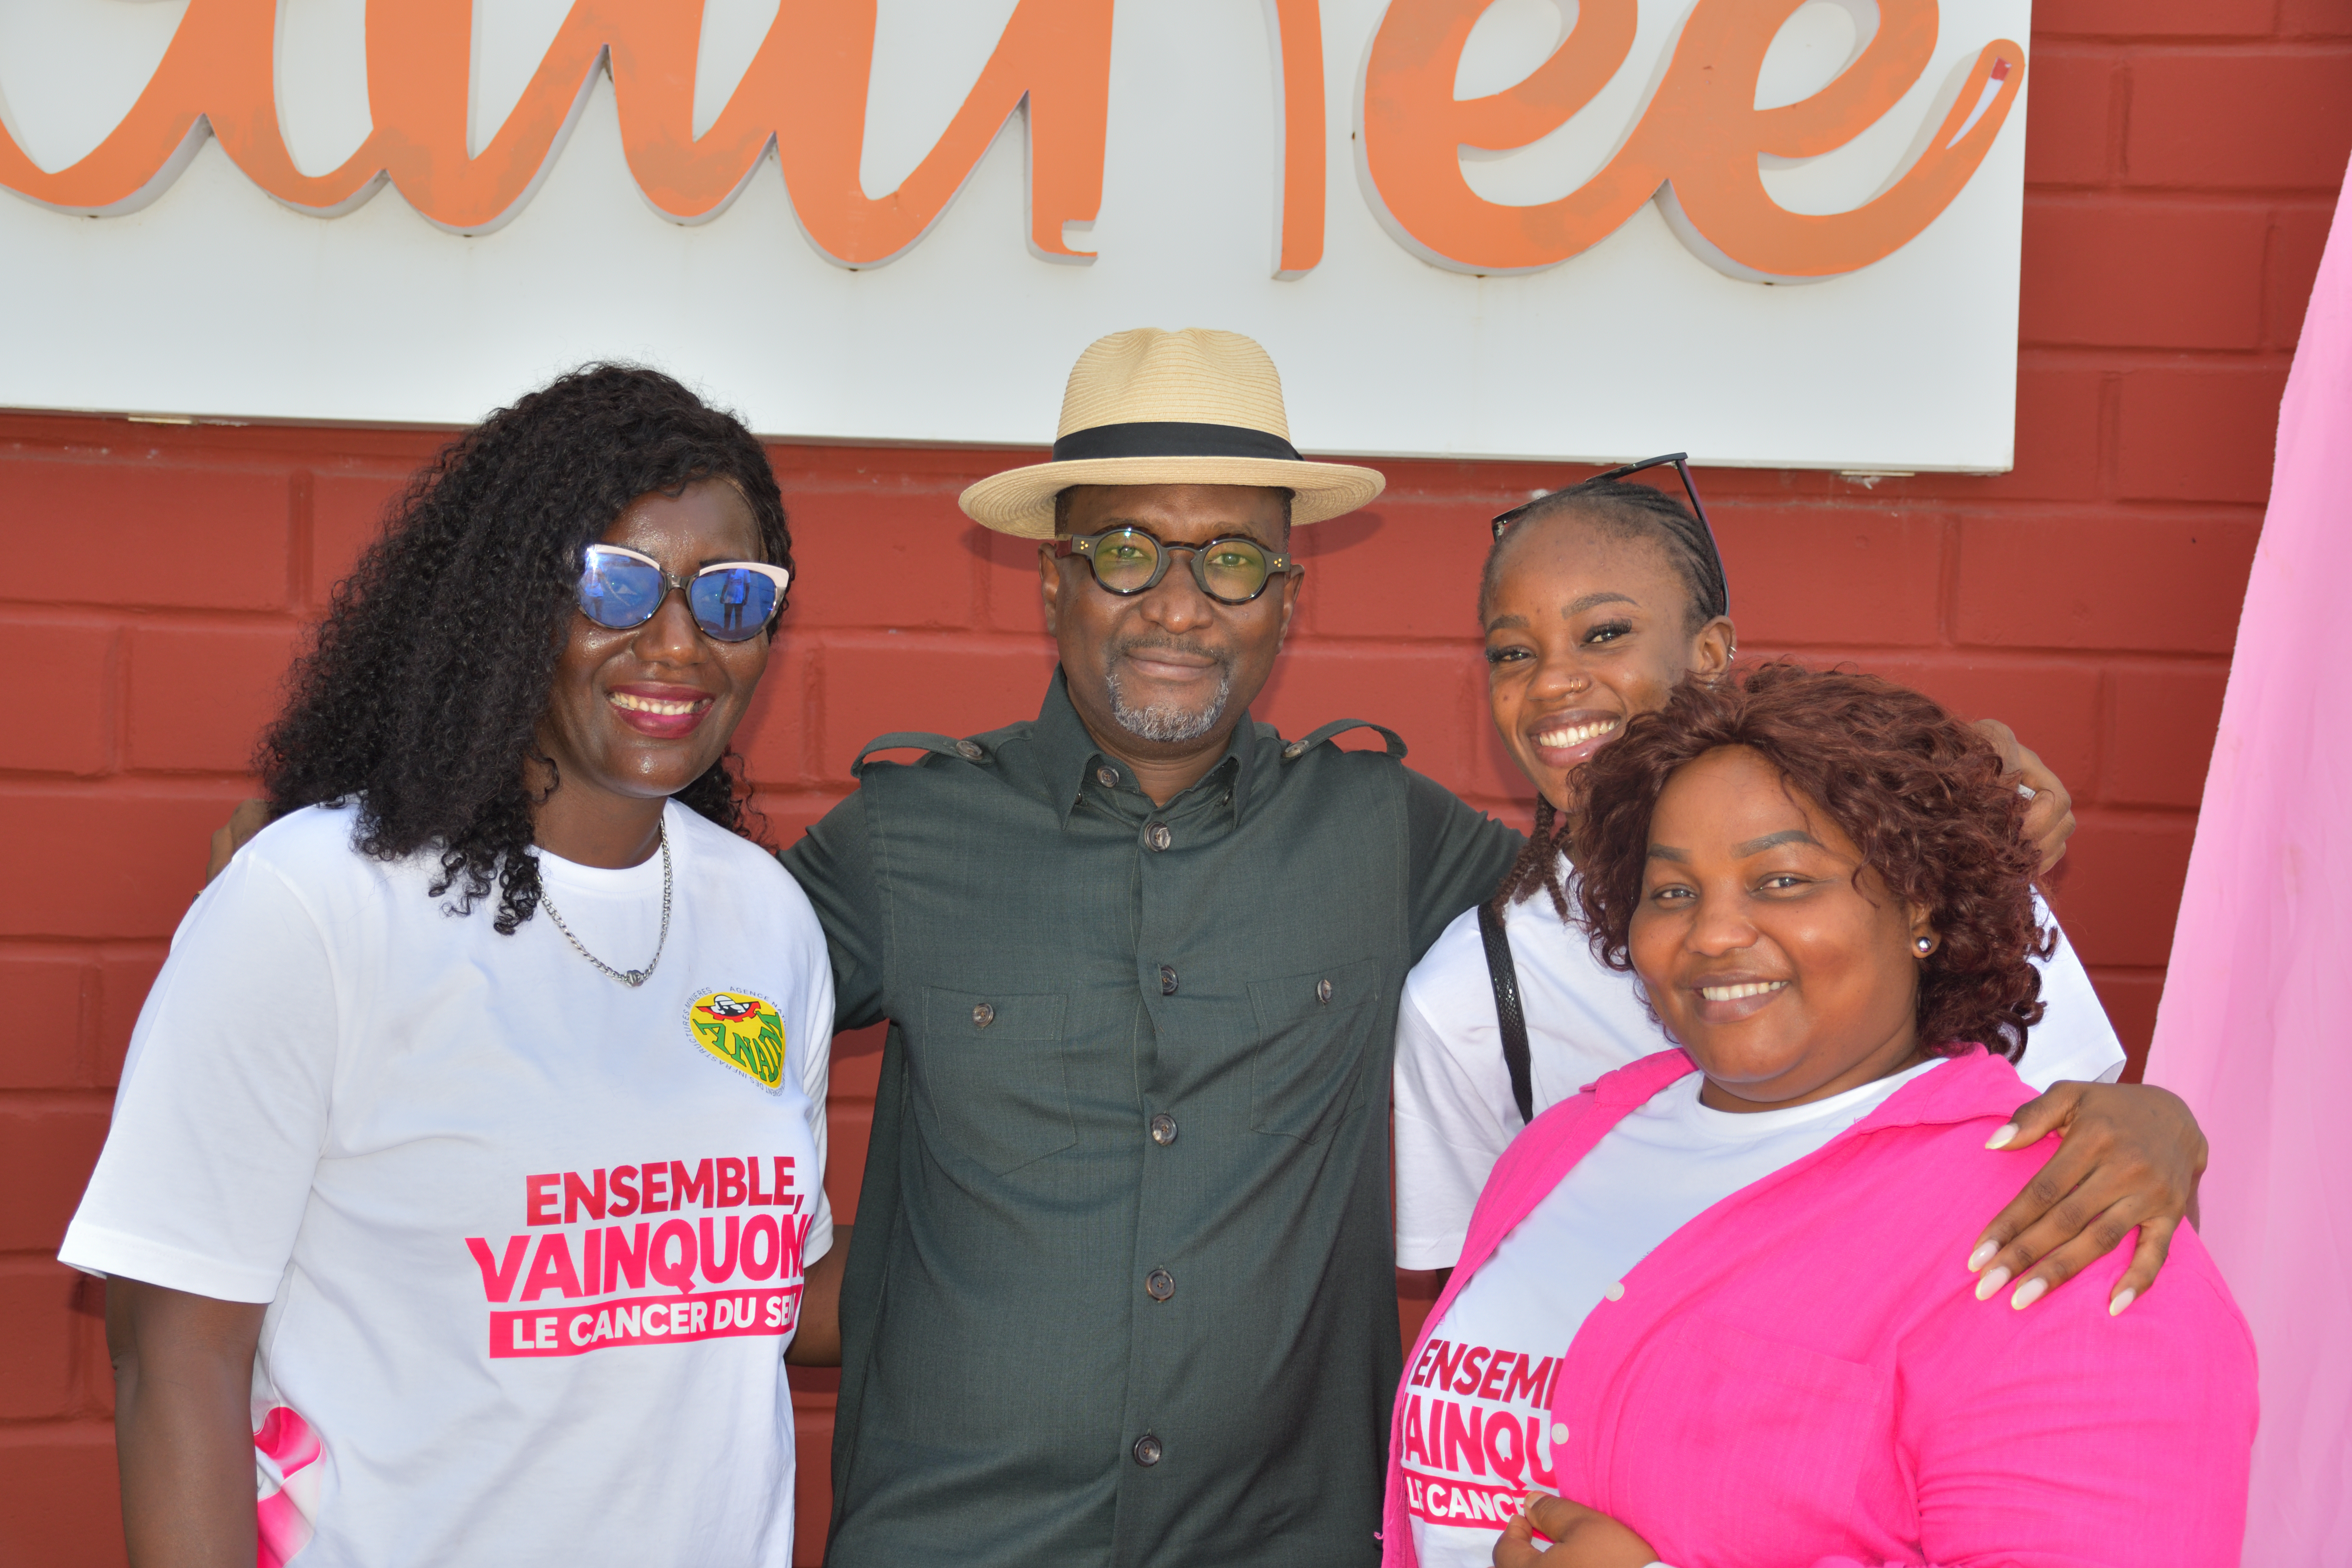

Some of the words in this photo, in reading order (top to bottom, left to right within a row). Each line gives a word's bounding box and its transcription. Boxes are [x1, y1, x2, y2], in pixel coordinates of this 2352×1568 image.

[685, 987, 712, 1010] MINIERES
[730, 986, 769, 1001] AGENCE
[683, 1009, 747, 1078] INFRASTRUCTURES
[750, 1077, 763, 1090] DES
[526, 1156, 803, 1227] ENSEMBLE,
[512, 1316, 558, 1349] LE
[569, 1301, 708, 1347] CANCER
[713, 1297, 756, 1329] DU
[1402, 1392, 1558, 1490] AINQU
[1407, 1477, 1424, 1512] LE
